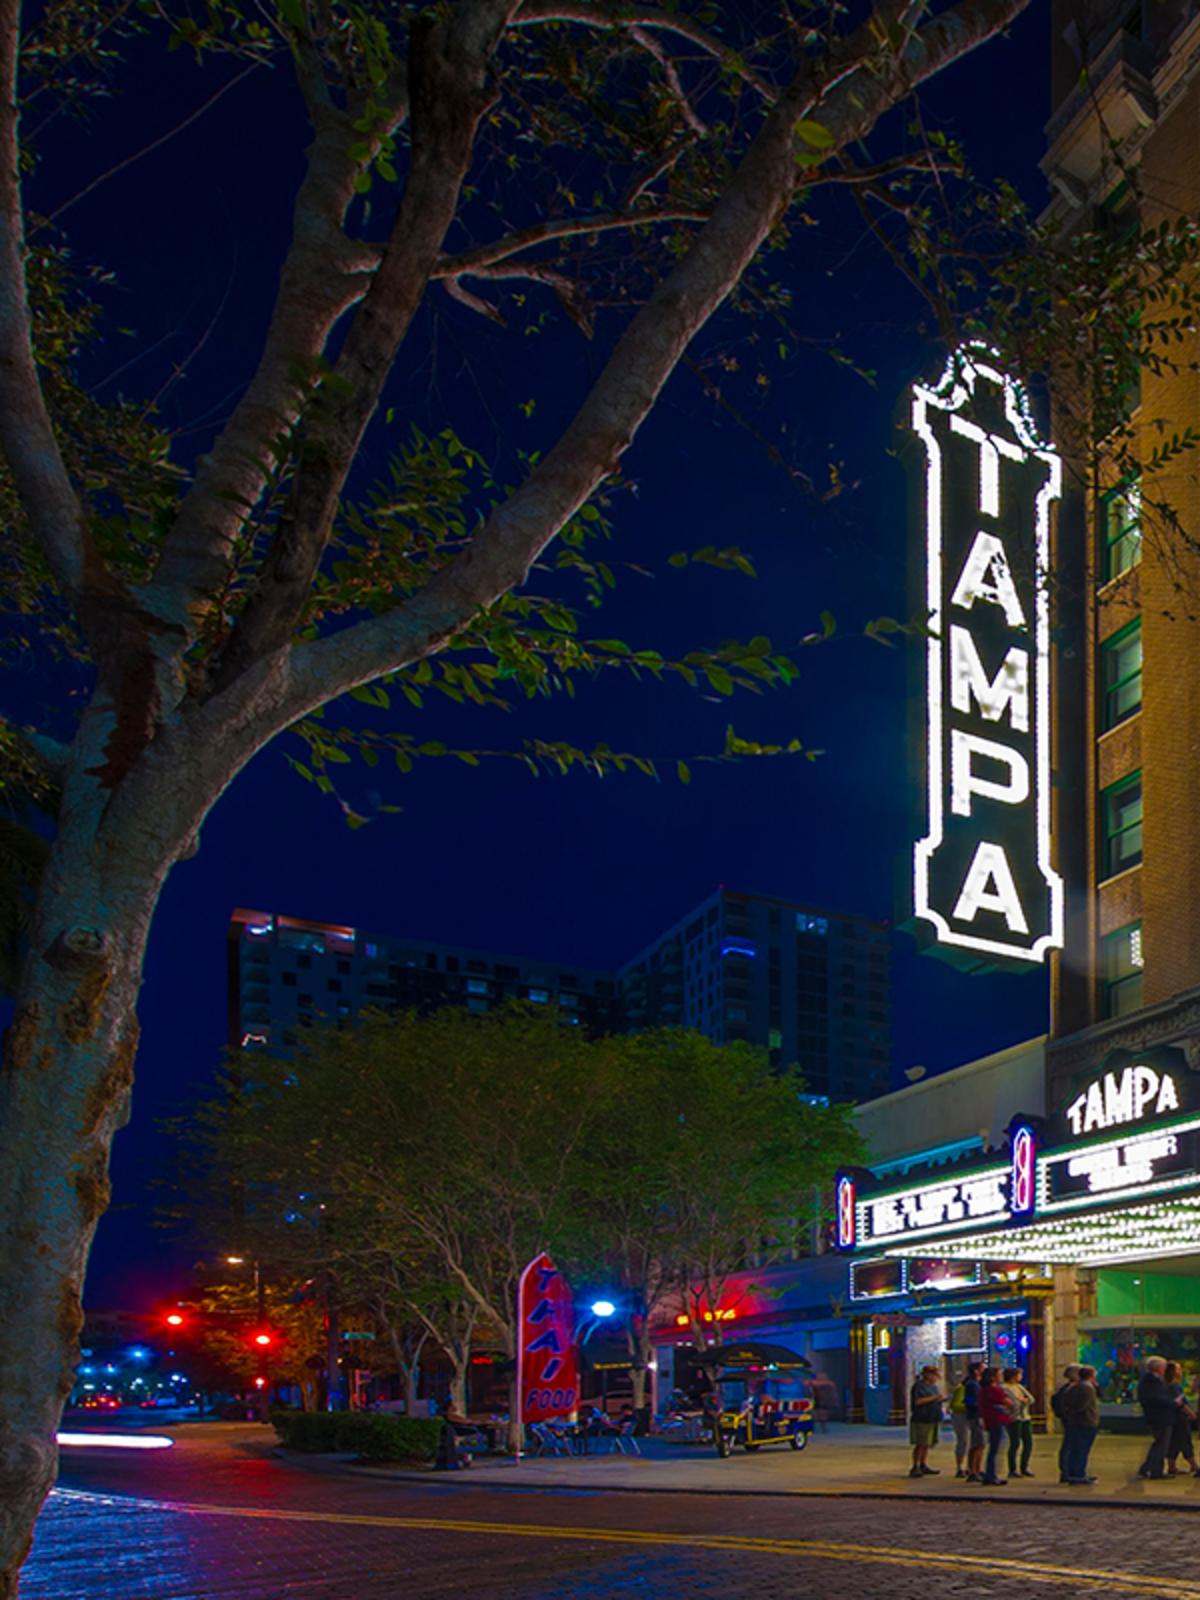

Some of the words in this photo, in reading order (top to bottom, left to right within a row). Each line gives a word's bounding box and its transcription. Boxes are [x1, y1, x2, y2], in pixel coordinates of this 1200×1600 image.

[949, 412, 1031, 936] TAMPA
[1066, 1065, 1180, 1136] TAMPA
[525, 1387, 577, 1411] FOOD
